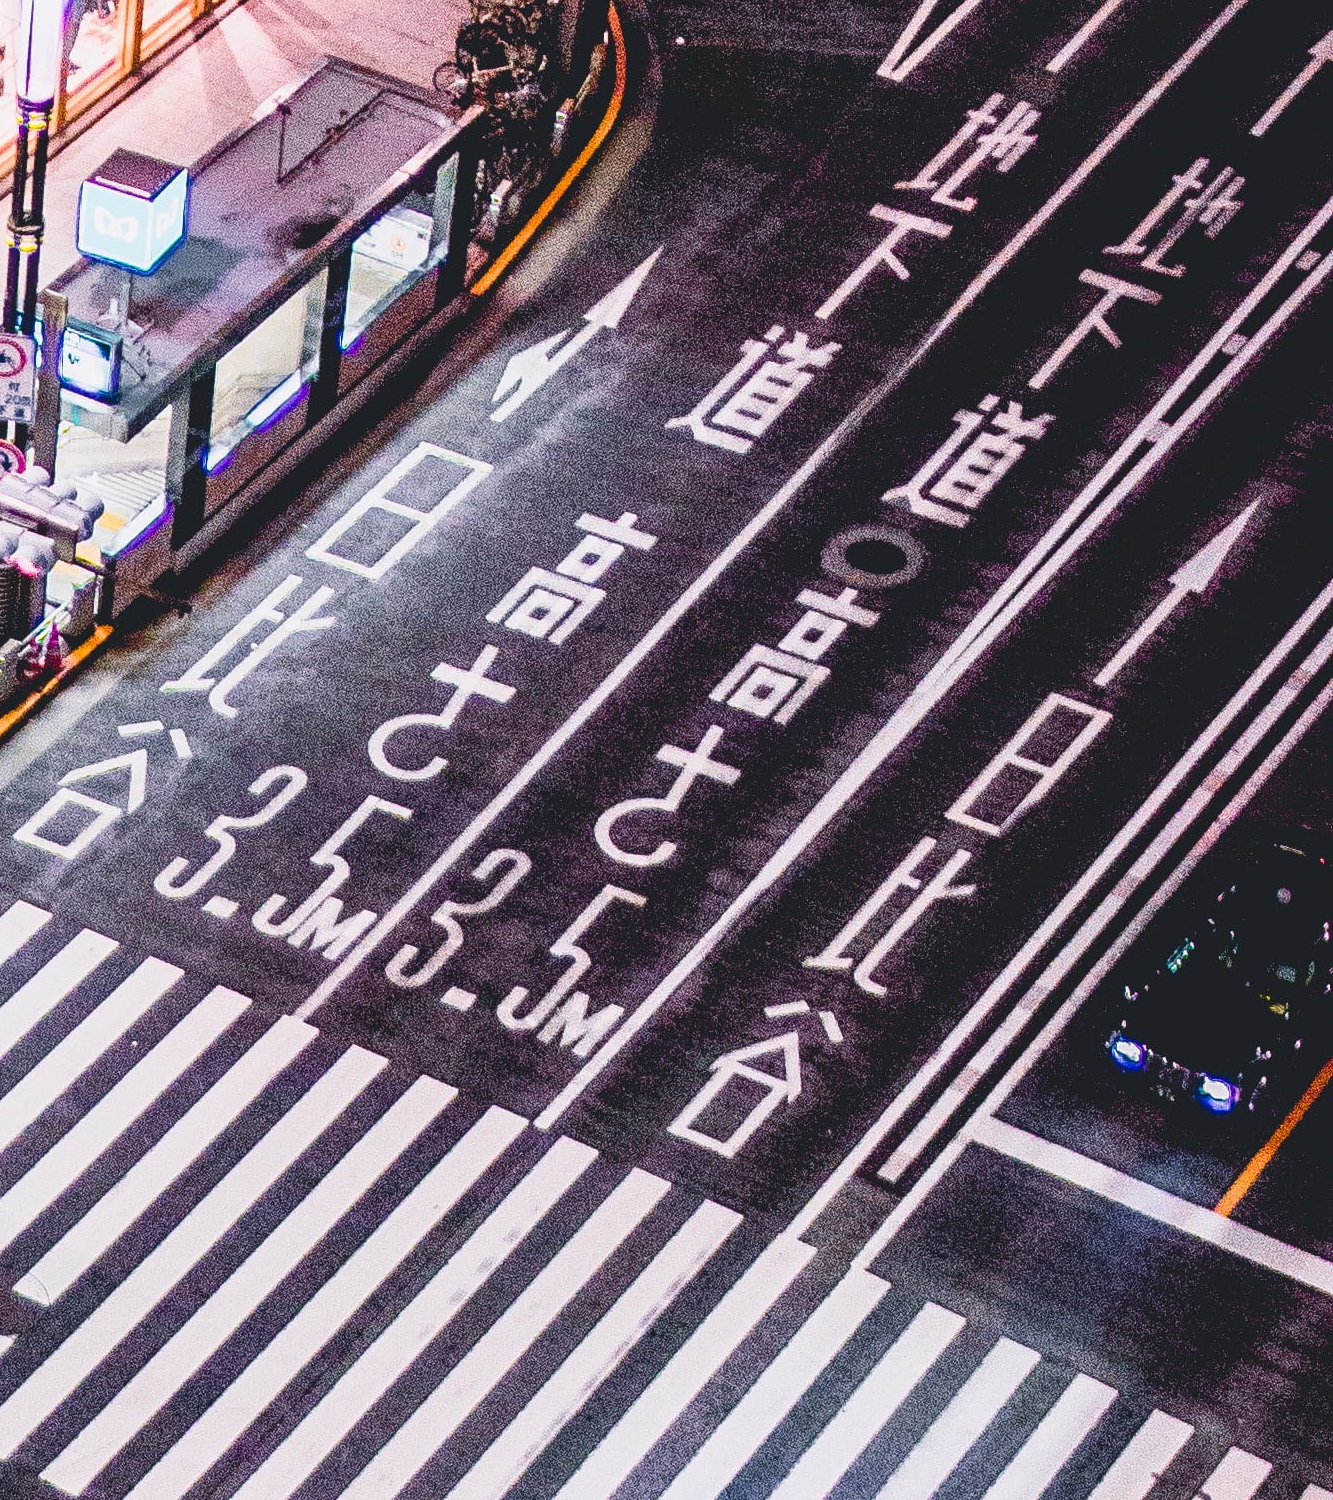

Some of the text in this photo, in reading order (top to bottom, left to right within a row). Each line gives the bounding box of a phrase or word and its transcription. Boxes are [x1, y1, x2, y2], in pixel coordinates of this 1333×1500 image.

[666, 92, 1040, 454] 地下道
[881, 155, 1245, 529] 地下道
[13, 441, 494, 860] 日比谷
[666, 691, 1114, 1160] 日比谷
